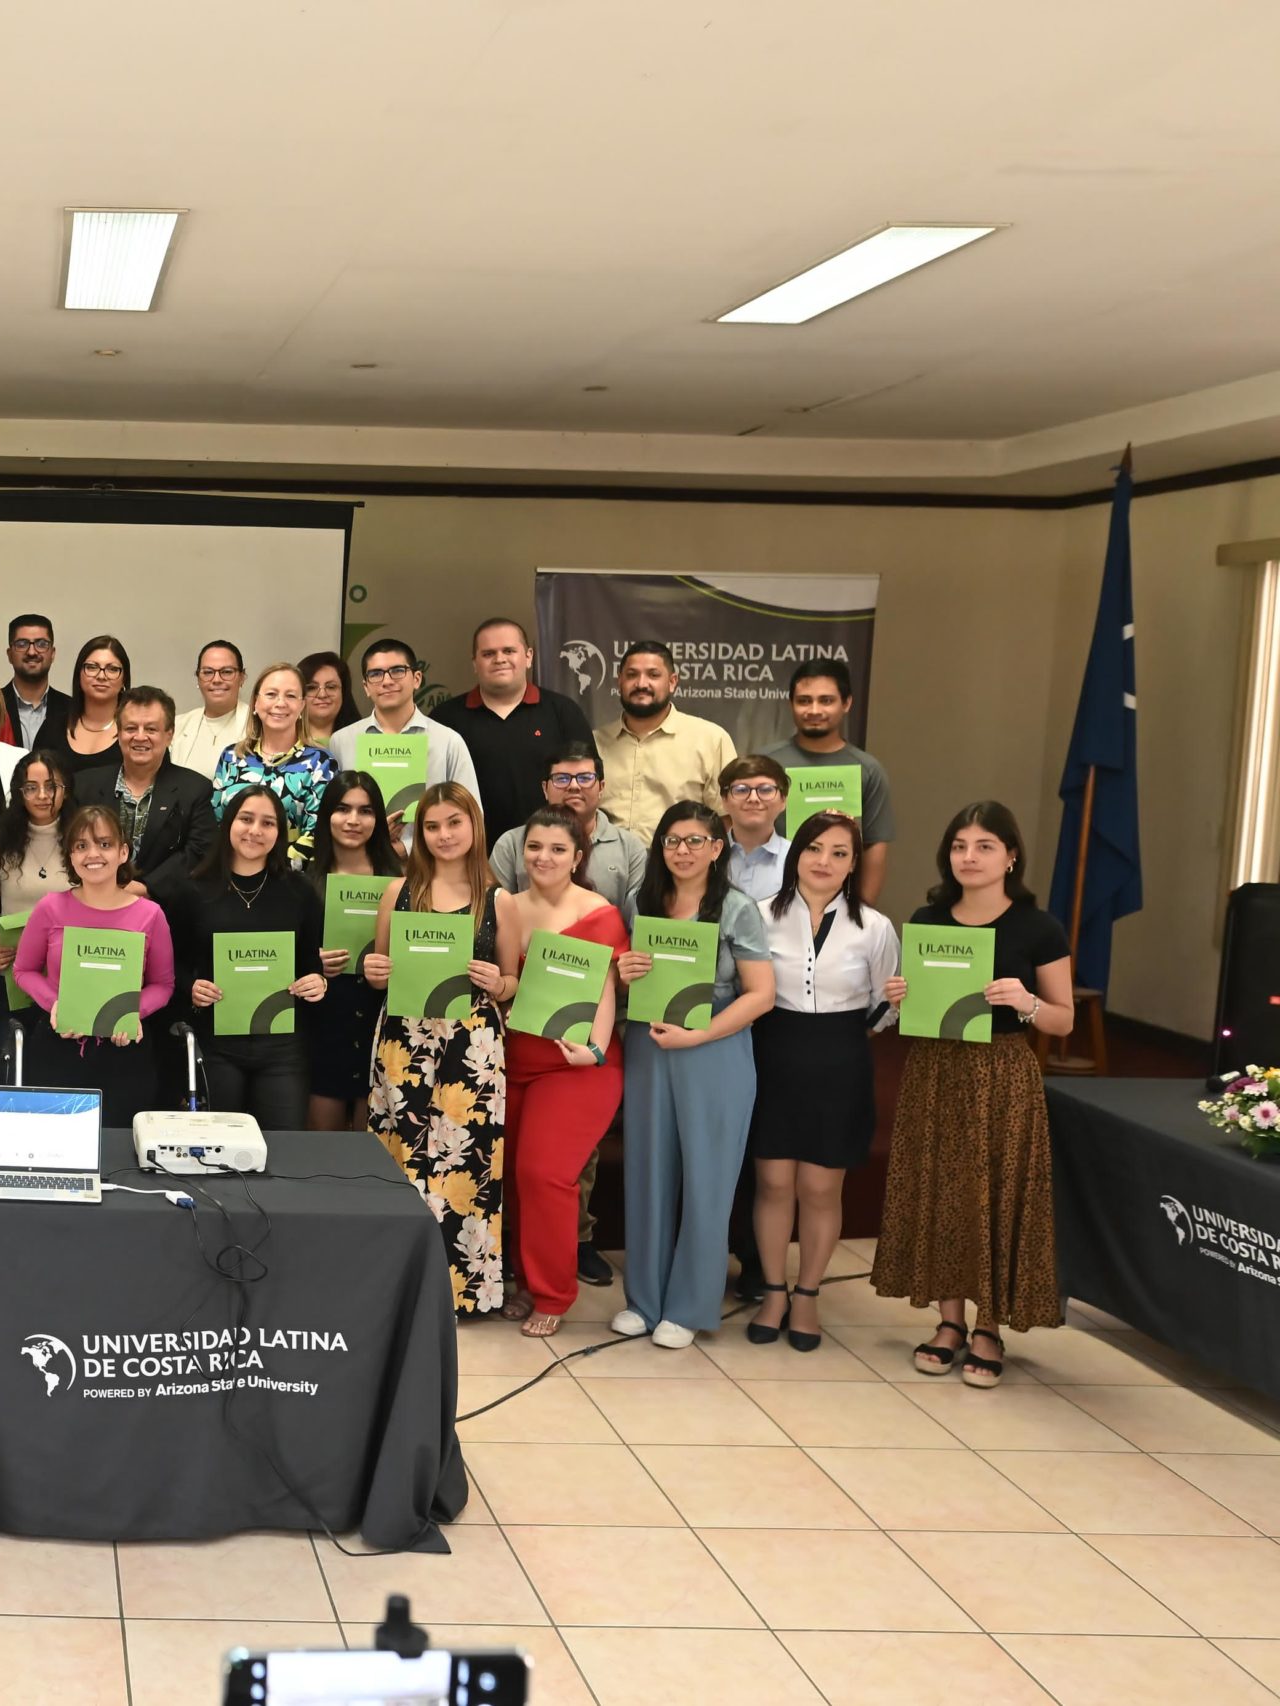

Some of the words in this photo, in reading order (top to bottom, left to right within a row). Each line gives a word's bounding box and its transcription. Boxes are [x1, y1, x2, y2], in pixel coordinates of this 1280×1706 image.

[613, 640, 764, 661] UERSIDAD
[771, 643, 849, 662] LATINA
[723, 663, 774, 682] RICA
[673, 686, 721, 699] Arizona
[724, 687, 757, 700] State
[405, 929, 455, 942] ULATINA
[648, 934, 699, 948] ULATINA
[77, 944, 126, 957] ULATINA
[228, 949, 277, 962] ULATINA
[542, 948, 590, 968] ULATINA
[919, 943, 974, 956] ULATINA
[1192, 1204, 1280, 1253] UNIVERSID
[1195, 1223, 1218, 1244] DE
[1219, 1232, 1270, 1267] COSTA
[1238, 1261, 1277, 1285] Arizona
[82, 1326, 251, 1355] UNIVERSIDAD
[259, 1327, 349, 1352] LATINA
[83, 1358, 116, 1378] DE
[122, 1354, 204, 1378] COSTA
[83, 1388, 135, 1399] POWERED
[138, 1388, 151, 1398] BY
[155, 1382, 210, 1397] Arizona
[247, 1375, 319, 1396] University
